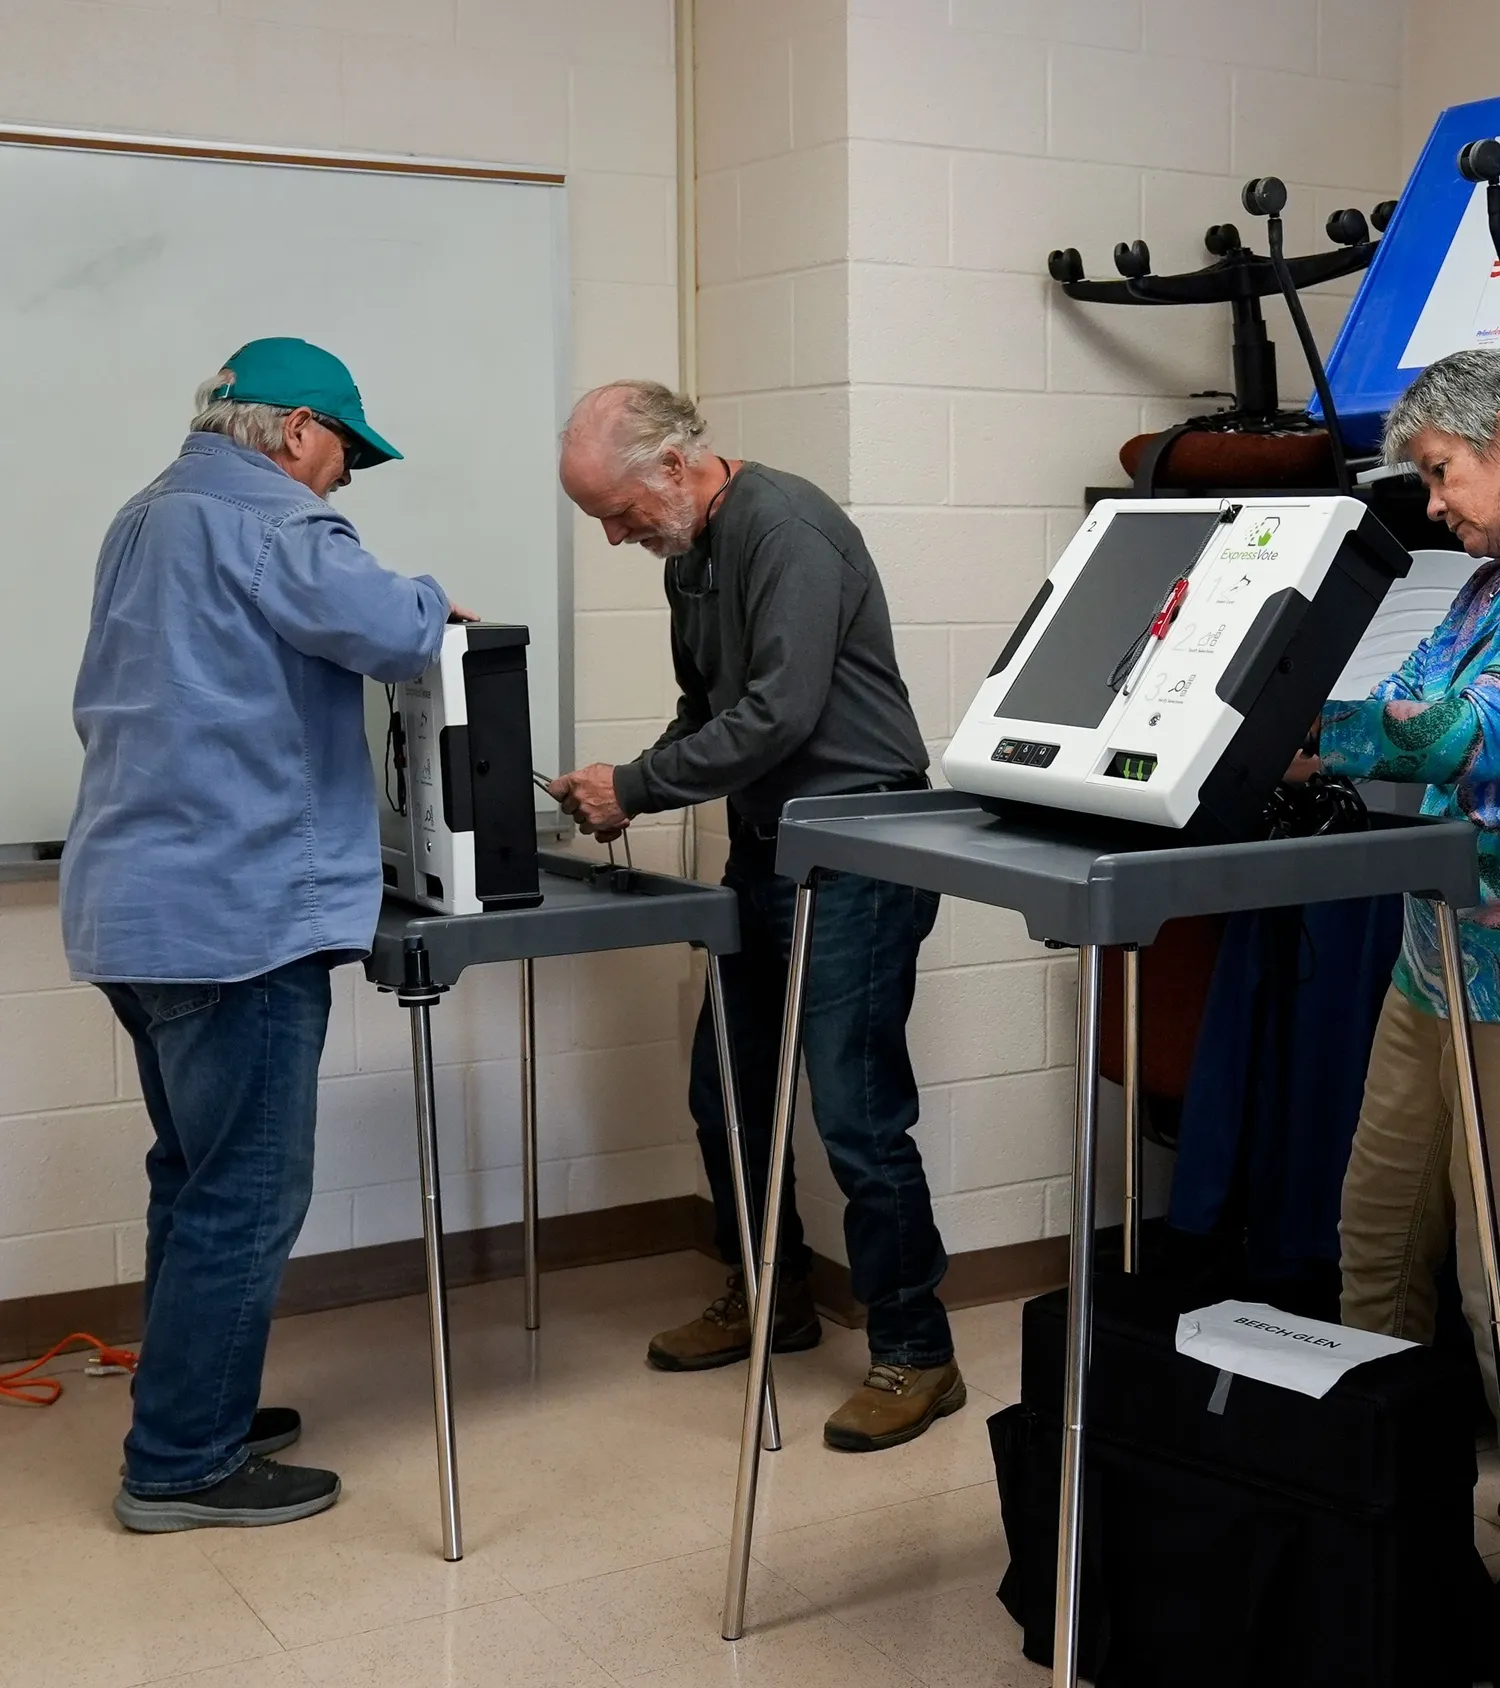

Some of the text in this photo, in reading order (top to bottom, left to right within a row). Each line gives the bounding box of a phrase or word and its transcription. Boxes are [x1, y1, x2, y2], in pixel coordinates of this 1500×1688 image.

[1086, 520, 1098, 533] 2
[1220, 547, 1279, 563] ExpressVote
[1172, 622, 1197, 651] 2
[1144, 672, 1168, 702] 3
[1233, 1317, 1342, 1349] BEECH GLEN
